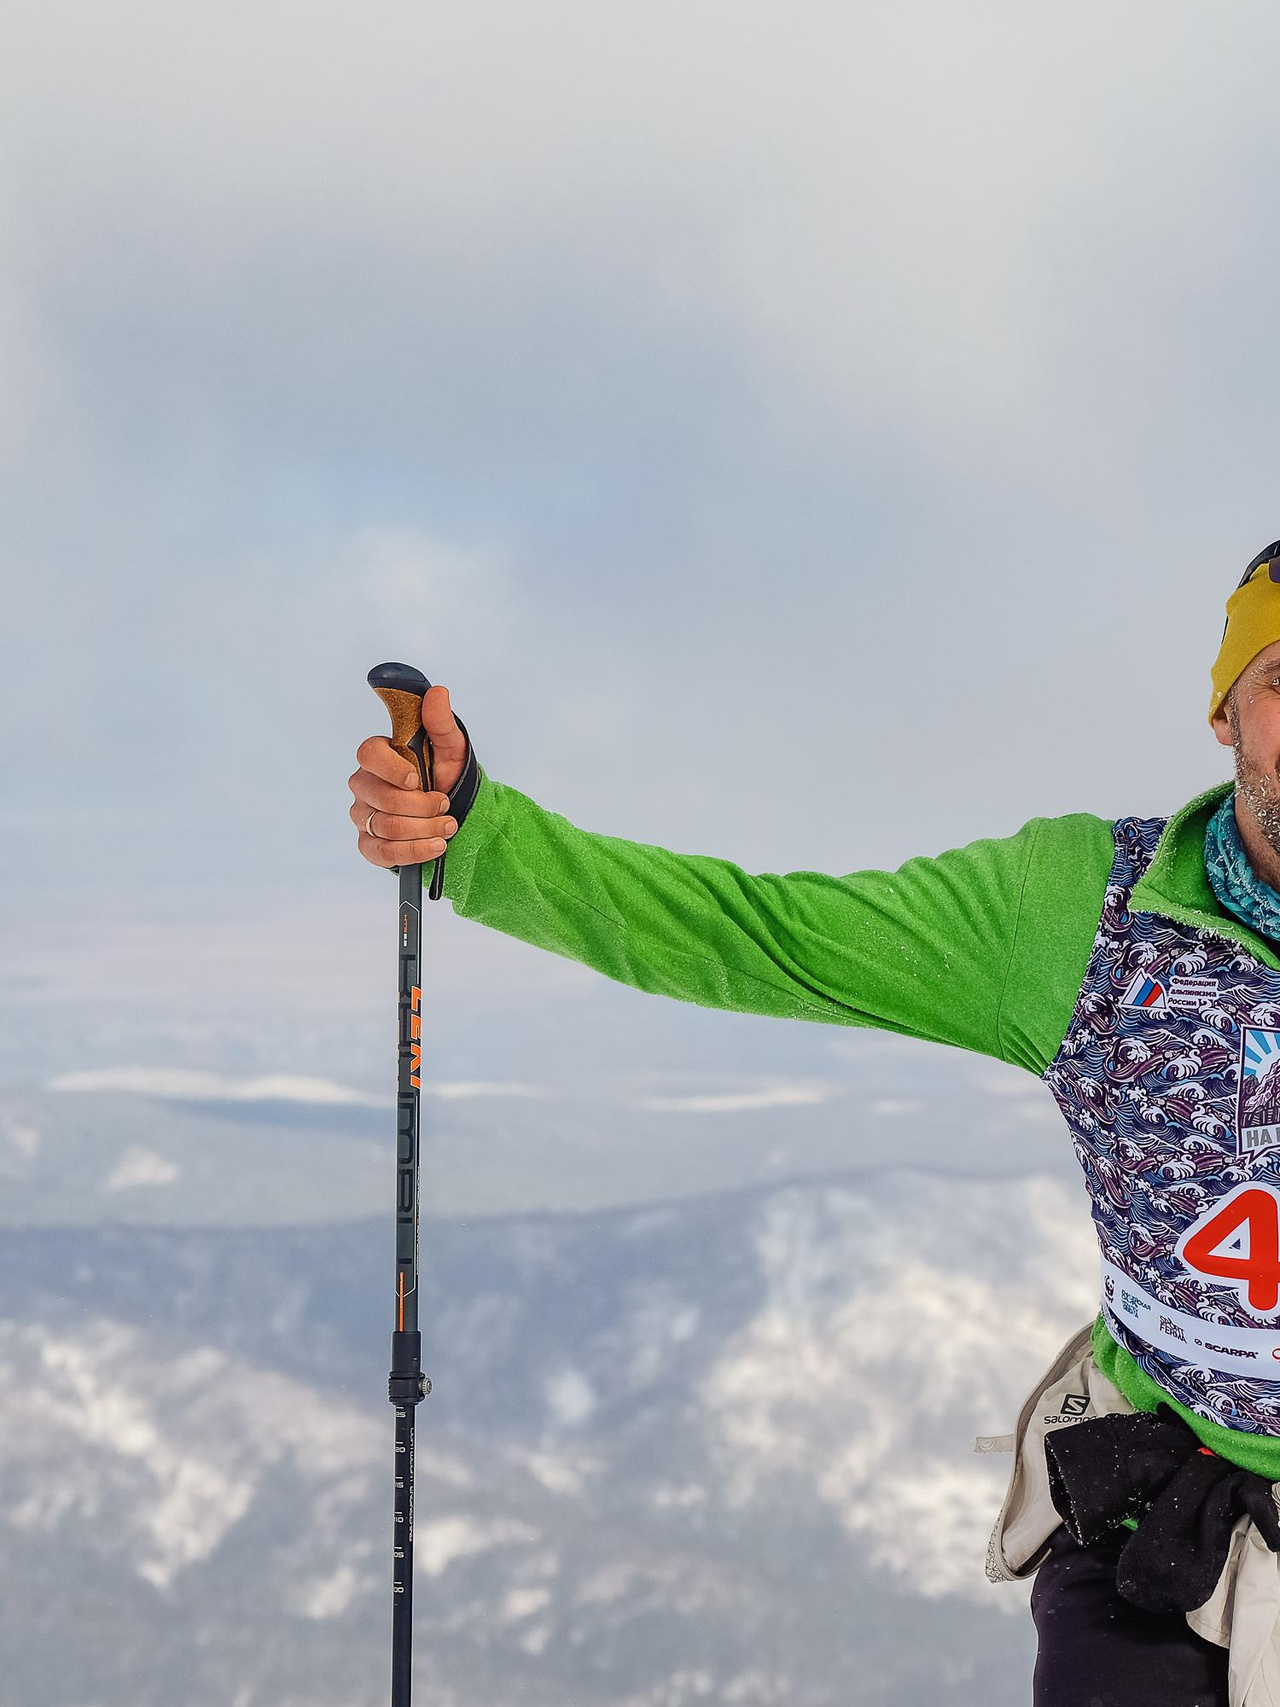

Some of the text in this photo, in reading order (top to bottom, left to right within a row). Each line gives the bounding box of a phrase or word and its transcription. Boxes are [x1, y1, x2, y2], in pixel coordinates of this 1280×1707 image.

[1171, 977, 1216, 987] Федерация
[1167, 997, 1197, 1006] России
[1246, 1128, 1272, 1148] НА
[1204, 1342, 1257, 1359] SCARPA
